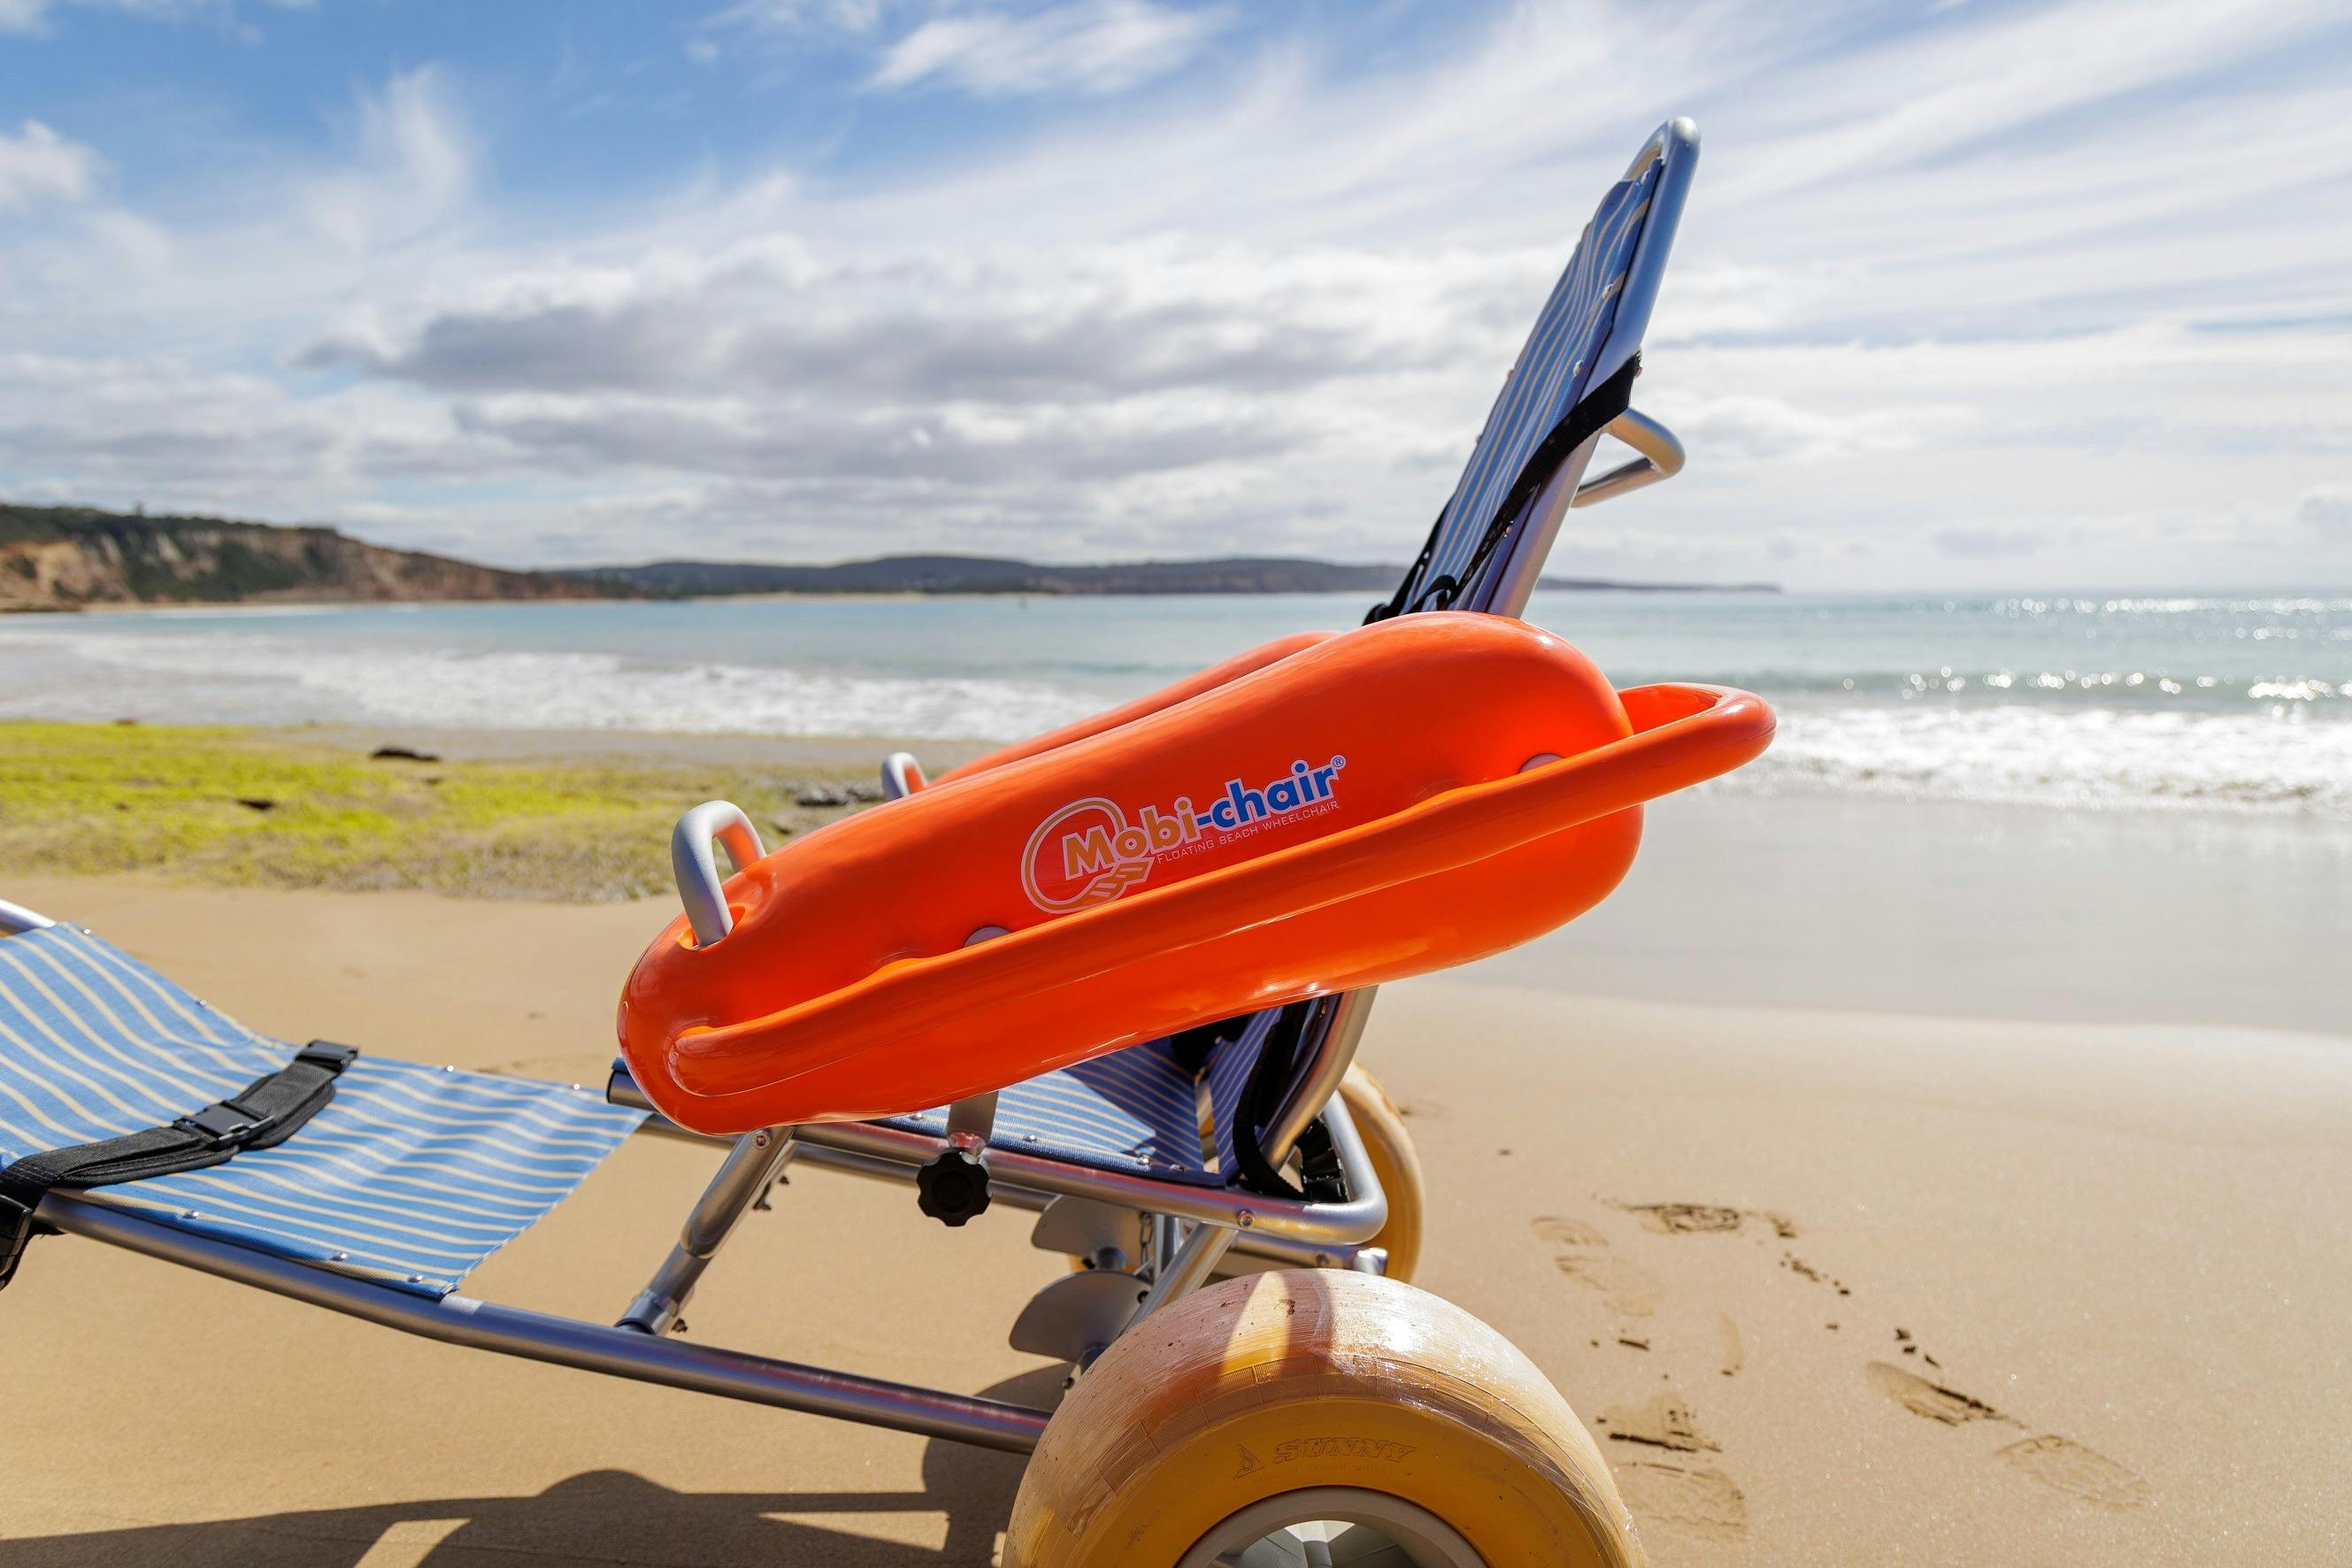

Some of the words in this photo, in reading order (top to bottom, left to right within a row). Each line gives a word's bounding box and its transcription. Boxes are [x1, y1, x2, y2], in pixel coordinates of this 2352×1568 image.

[1157, 839, 1216, 865] FLOATING
[1219, 825, 1260, 845] BEACH
[1262, 800, 1340, 832] WHEELCHAIR
[1273, 1436, 1417, 1464] SUNNY
